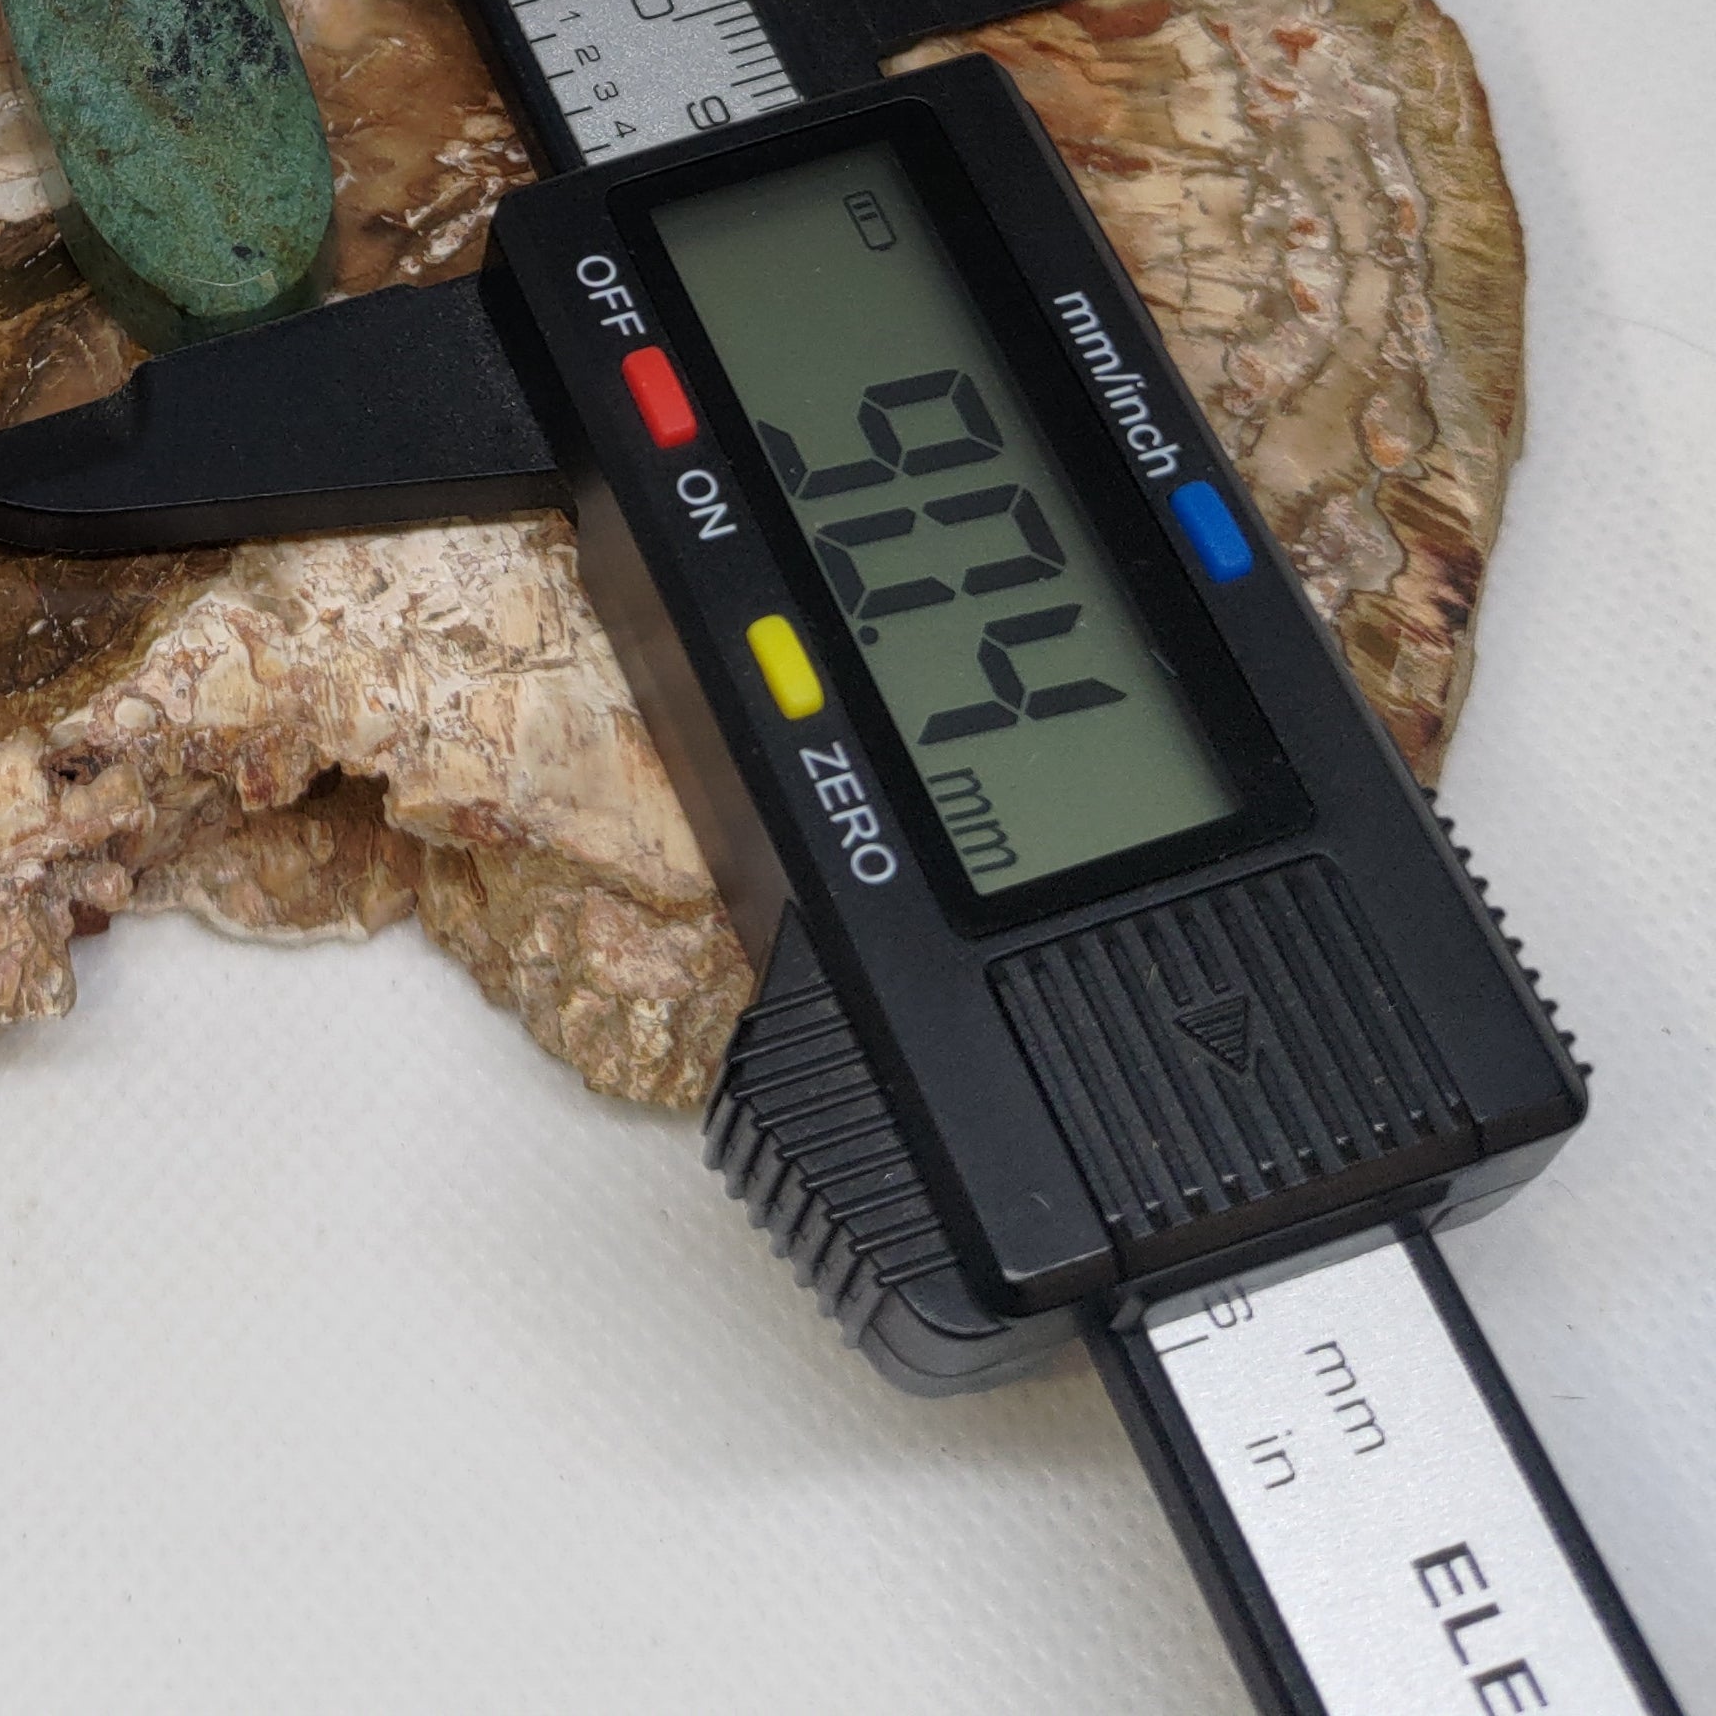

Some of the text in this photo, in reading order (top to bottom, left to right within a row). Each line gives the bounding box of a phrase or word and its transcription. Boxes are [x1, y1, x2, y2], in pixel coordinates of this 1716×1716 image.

[559, 10, 581, 23] 1
[574, 45, 601, 66] 2
[593, 81, 619, 101] 3
[614, 121, 637, 138] 4
[576, 254, 647, 338] OFF
[1054, 290, 1181, 479] mm/inch
[675, 468, 738, 542] ON
[756, 368, 1128, 875] 90.4 mm
[799, 739, 898, 884] ZERO
[1246, 1429, 1296, 1490] in
[1304, 1340, 1386, 1455] mm
[1411, 1541, 1548, 1716] ELE
